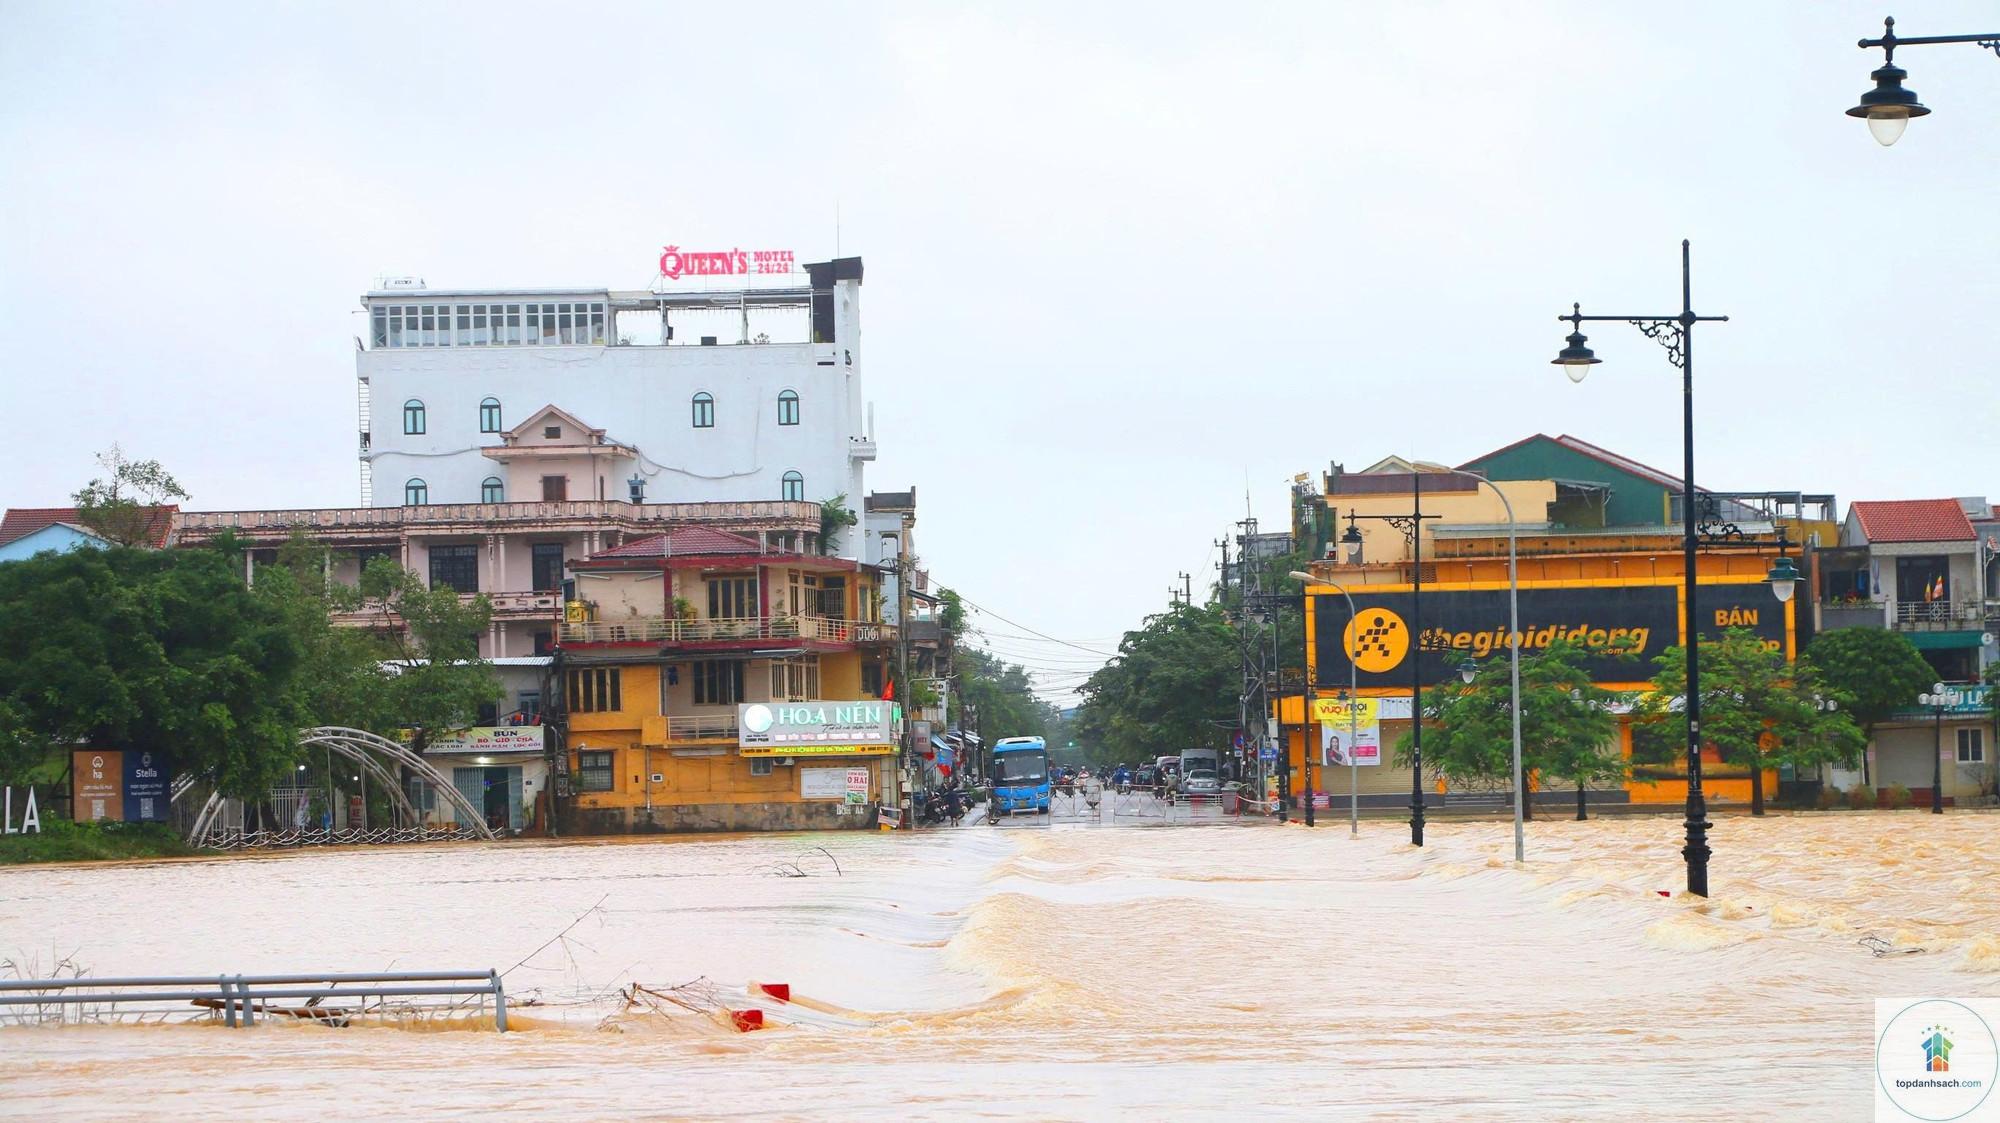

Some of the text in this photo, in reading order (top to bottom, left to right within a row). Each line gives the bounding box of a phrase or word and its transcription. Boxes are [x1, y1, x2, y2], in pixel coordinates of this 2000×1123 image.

[660, 247, 748, 280] QUEEN'S
[753, 250, 794, 263] MOTEL
[757, 262, 789, 274] 24/24
[1714, 605, 1758, 627] BÁN
[778, 706, 828, 725] HOA
[135, 767, 158, 779] Stella
[0, 785, 41, 834] LA
